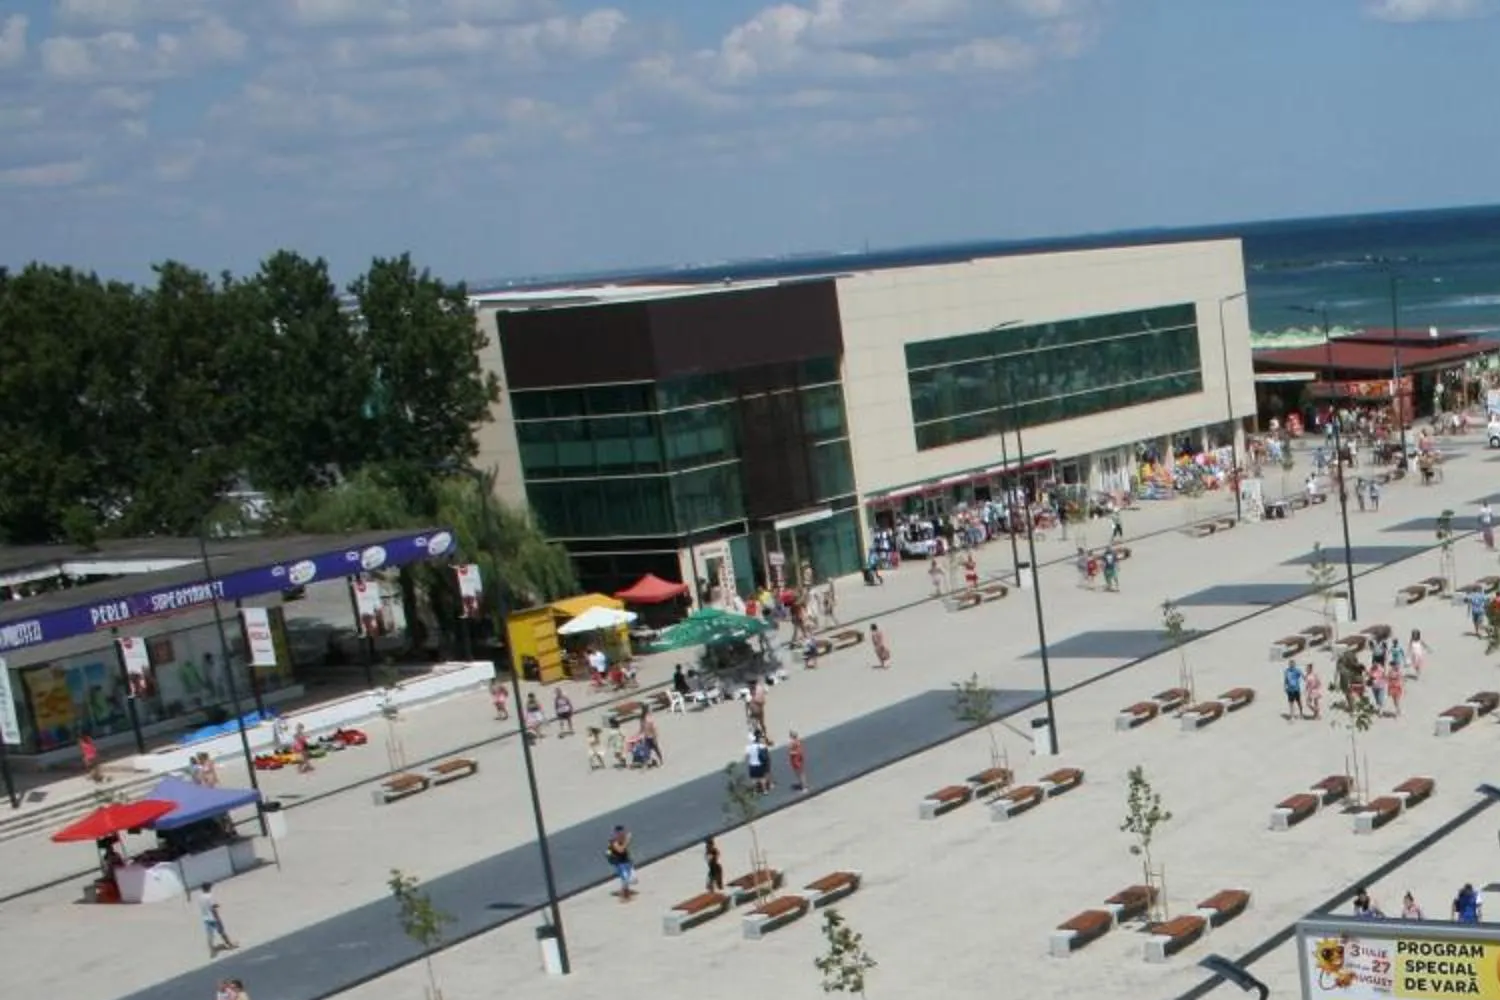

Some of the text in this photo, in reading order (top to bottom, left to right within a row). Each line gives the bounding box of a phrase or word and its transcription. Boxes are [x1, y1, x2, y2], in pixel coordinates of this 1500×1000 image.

[1397, 941, 1484, 958] PROGRAM
[1372, 959, 1391, 974] 27
[1405, 959, 1477, 976] SPECIAL
[1405, 977, 1427, 991] DE
